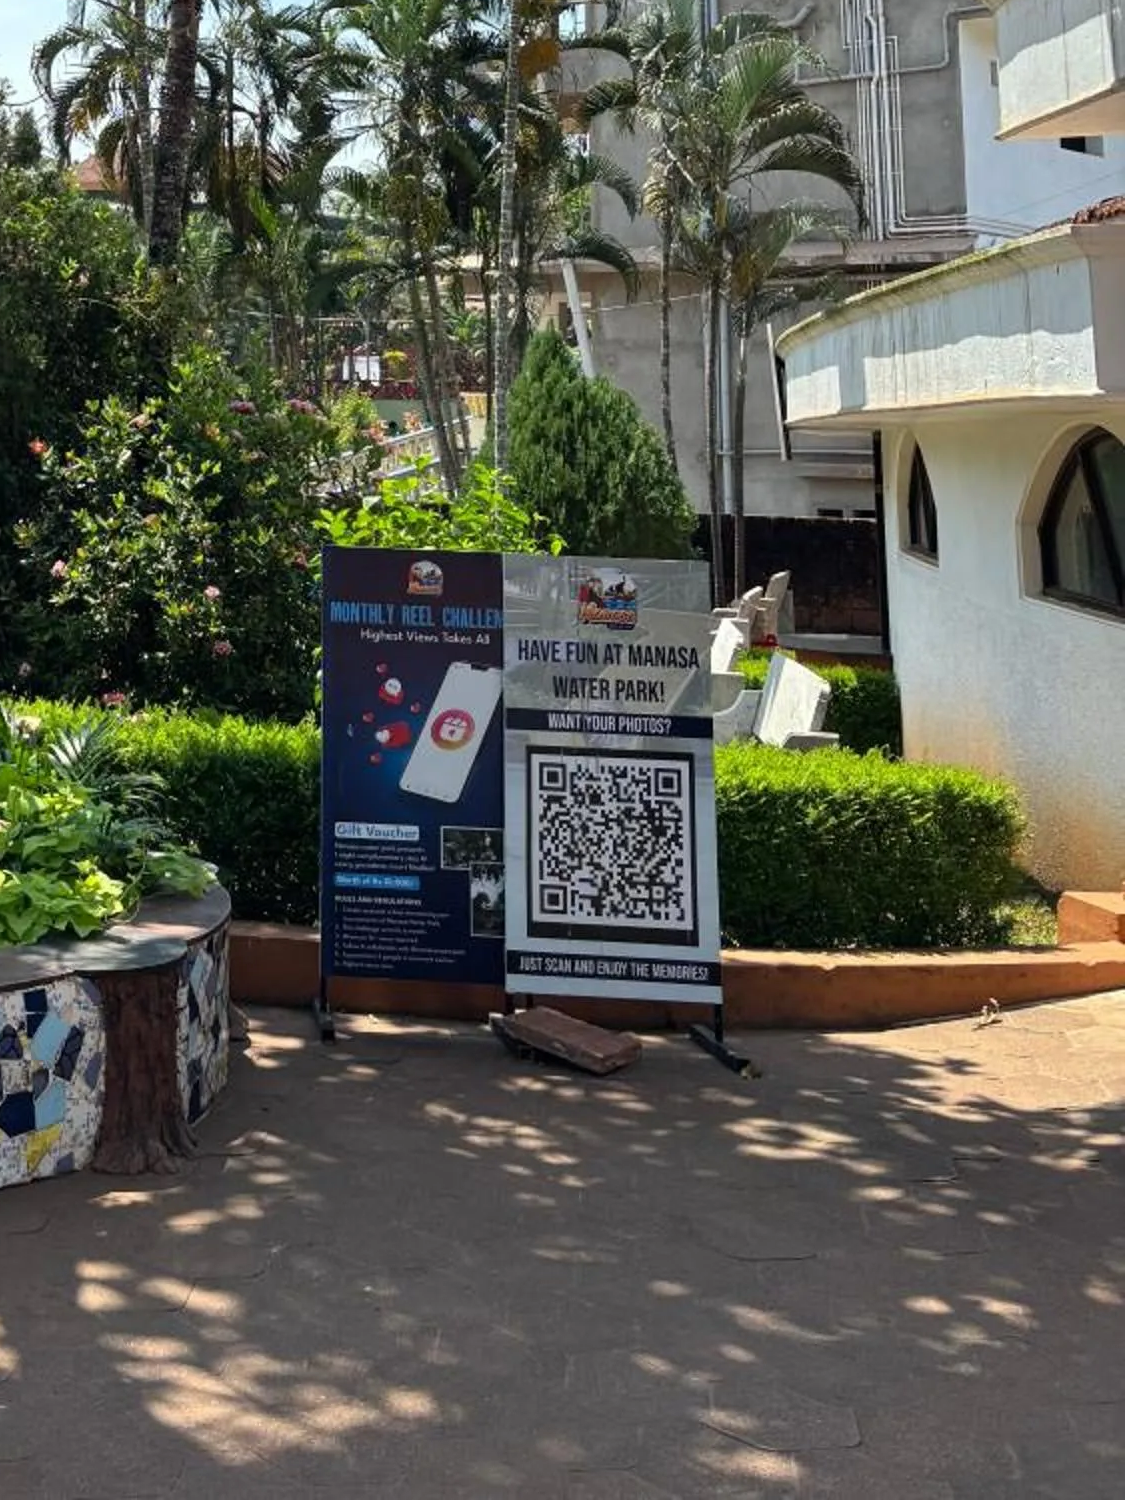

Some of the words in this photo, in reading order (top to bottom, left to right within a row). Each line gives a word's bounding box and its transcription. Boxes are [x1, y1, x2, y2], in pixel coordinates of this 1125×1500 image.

[330, 601, 394, 625] MONTHLY
[402, 604, 435, 627] REEL
[360, 628, 404, 643] Highest
[407, 630, 439, 644] Views
[442, 632, 472, 645] Takes
[518, 638, 563, 663] HAVE
[565, 641, 598, 665] FUN
[603, 643, 623, 666] AT
[628, 644, 700, 669] MANASA
[553, 675, 610, 700] WATER
[614, 679, 665, 703] PARK!
[547, 712, 581, 730] WANT
[584, 714, 617, 732] YOUR
[619, 716, 672, 734] PHOTOS?
[336, 823, 363, 837] Gift
[366, 826, 418, 839] Voucher
[519, 955, 543, 972] JUST
[544, 956, 572, 974] SCAN
[574, 958, 595, 975] AND
[597, 960, 627, 977] ENJOY
[631, 962, 649, 979] THE
[652, 963, 709, 981] MEMORIES!
